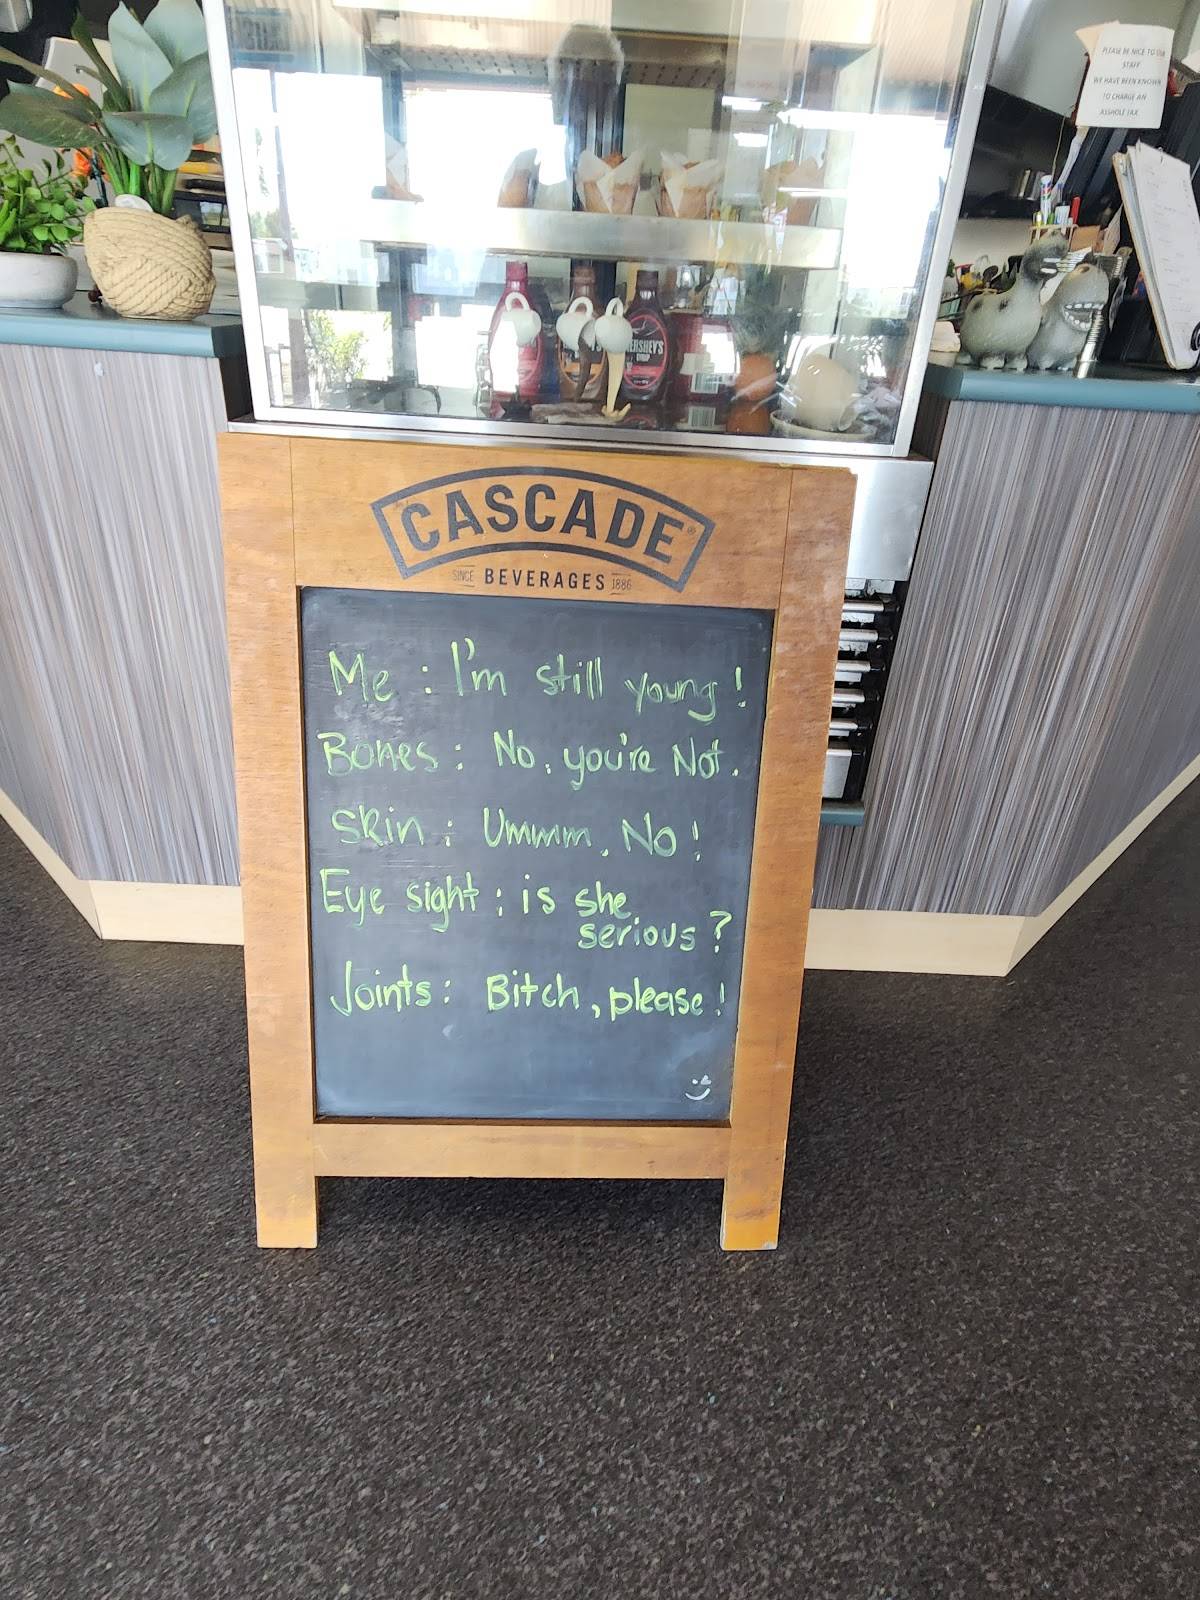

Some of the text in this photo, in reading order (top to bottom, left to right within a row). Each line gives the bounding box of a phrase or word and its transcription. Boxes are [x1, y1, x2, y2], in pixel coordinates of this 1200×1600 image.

[1102, 46, 1121, 55] PLEASE
[1122, 47, 1131, 55] BE
[1132, 48, 1146, 56] NICE
[1147, 48, 1156, 56] TO
[1122, 61, 1141, 69] STAFF
[1104, 77, 1120, 85] HAVE
[1121, 78, 1136, 86] BEEN
[1112, 93, 1135, 101] CHARGE
[1127, 109, 1139, 117] TAX
[401, 483, 684, 565] CASCADE
[452, 569, 474, 583] SINCE
[484, 568, 605, 591] BEVERAGES
[611, 577, 633, 591] 1886
[450, 637, 507, 697] I'm
[535, 653, 603, 700] still
[563, 732, 657, 791] you're
[320, 867, 386, 928] Eye
[521, 873, 556, 915] is
[574, 880, 631, 919] she
